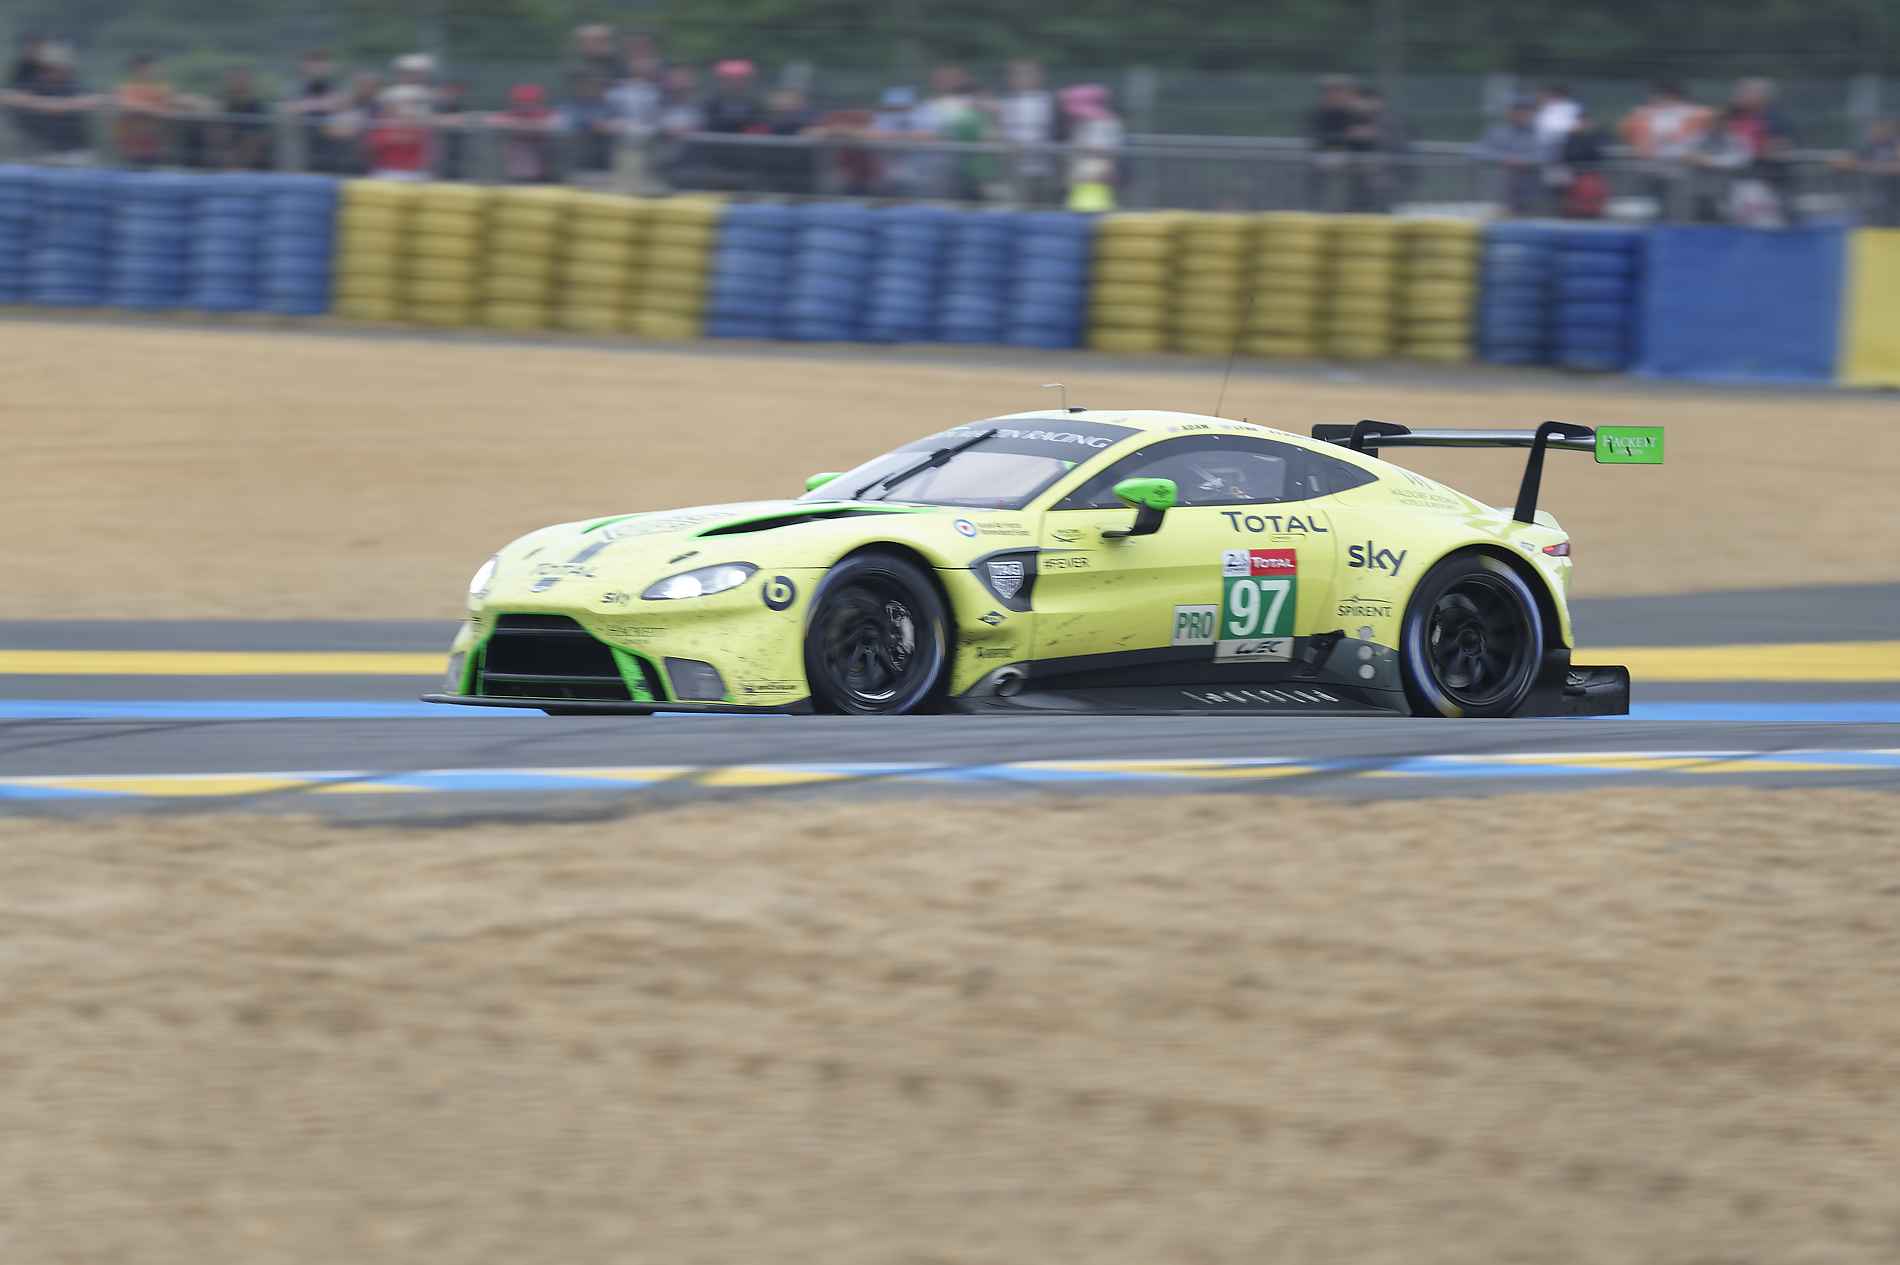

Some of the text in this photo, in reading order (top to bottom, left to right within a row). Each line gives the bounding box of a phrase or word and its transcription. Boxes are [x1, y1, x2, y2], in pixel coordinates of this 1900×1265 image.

[1220, 511, 1329, 533] TOTAL
[1250, 556, 1296, 568] TOTAL
[1348, 540, 1408, 577] sky
[1228, 579, 1291, 636] 97
[1336, 605, 1393, 617] SPIRENT
[1175, 611, 1214, 640] PRO
